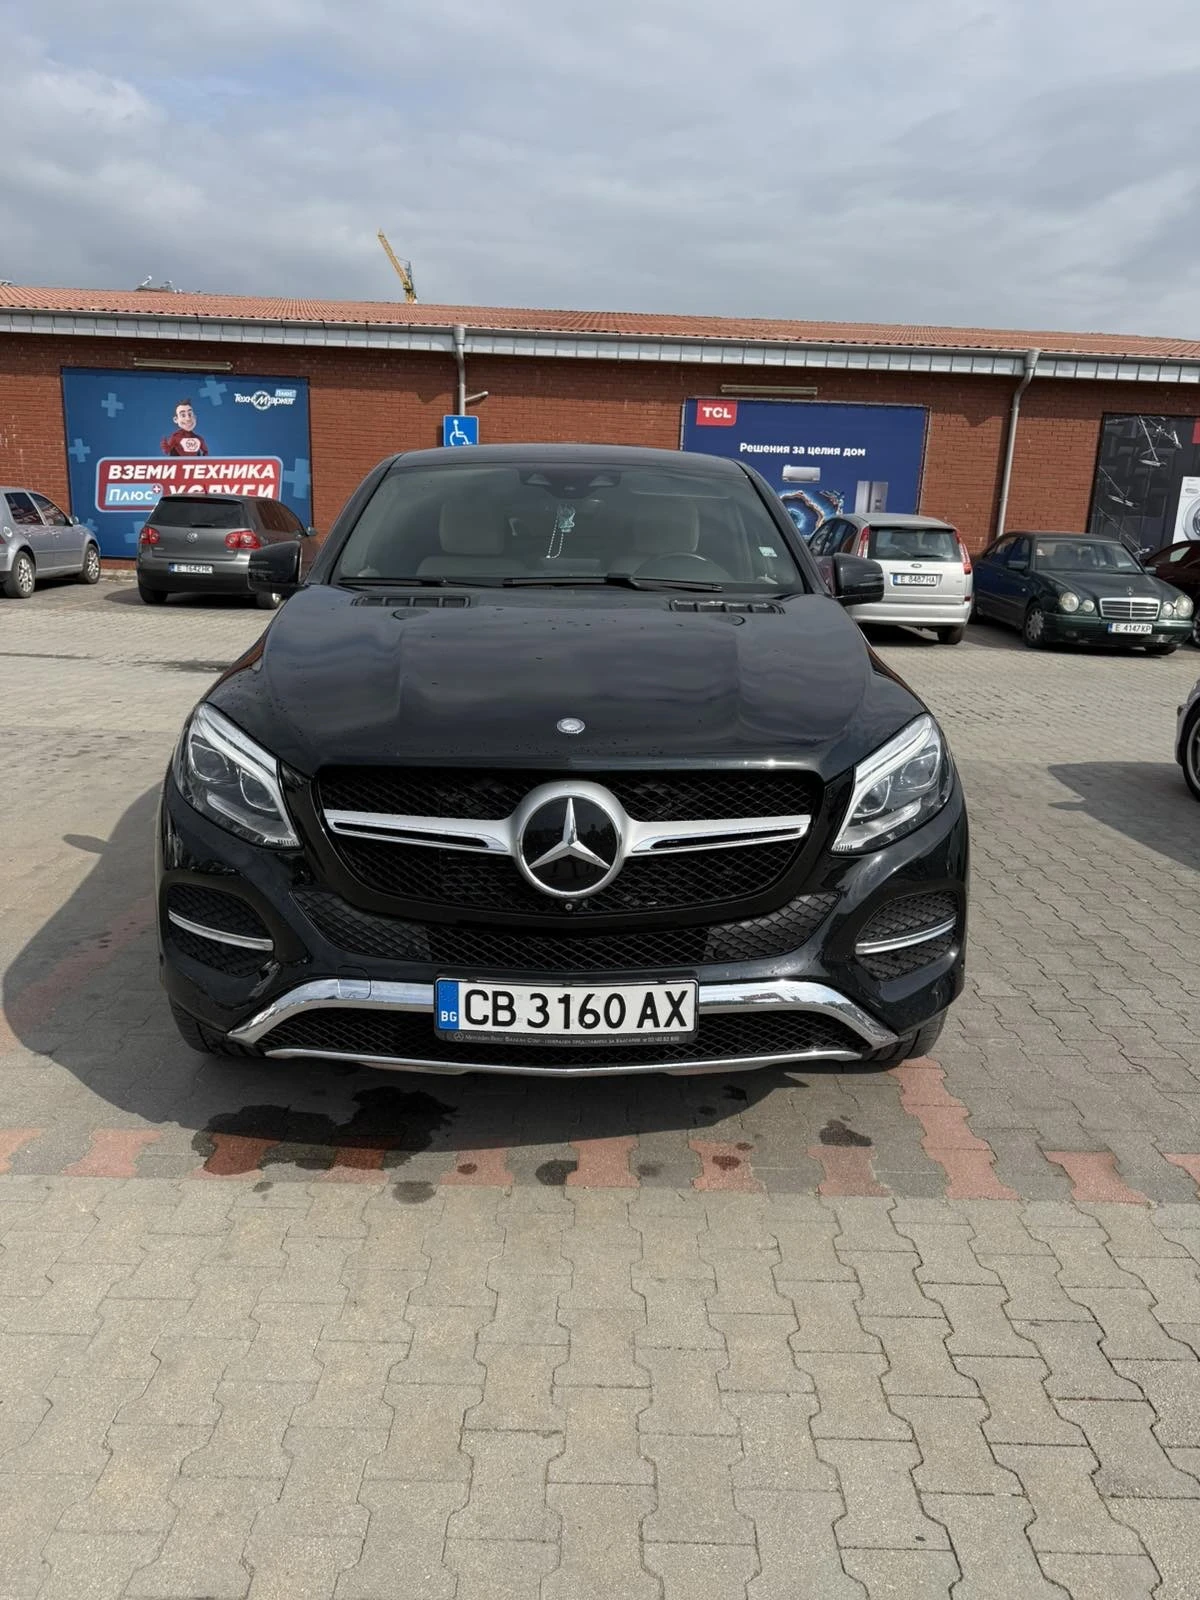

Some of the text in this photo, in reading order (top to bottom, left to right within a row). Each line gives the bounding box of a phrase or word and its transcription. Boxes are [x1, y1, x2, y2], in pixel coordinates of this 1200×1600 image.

[702, 407, 732, 418] TCL
[740, 442, 866, 457] Решения за целия дом
[108, 464, 275, 480] ВЗЕМИ ТЕХНИКА
[441, 1011, 458, 1023] BG
[465, 989, 688, 1030] CB 3160 AX
